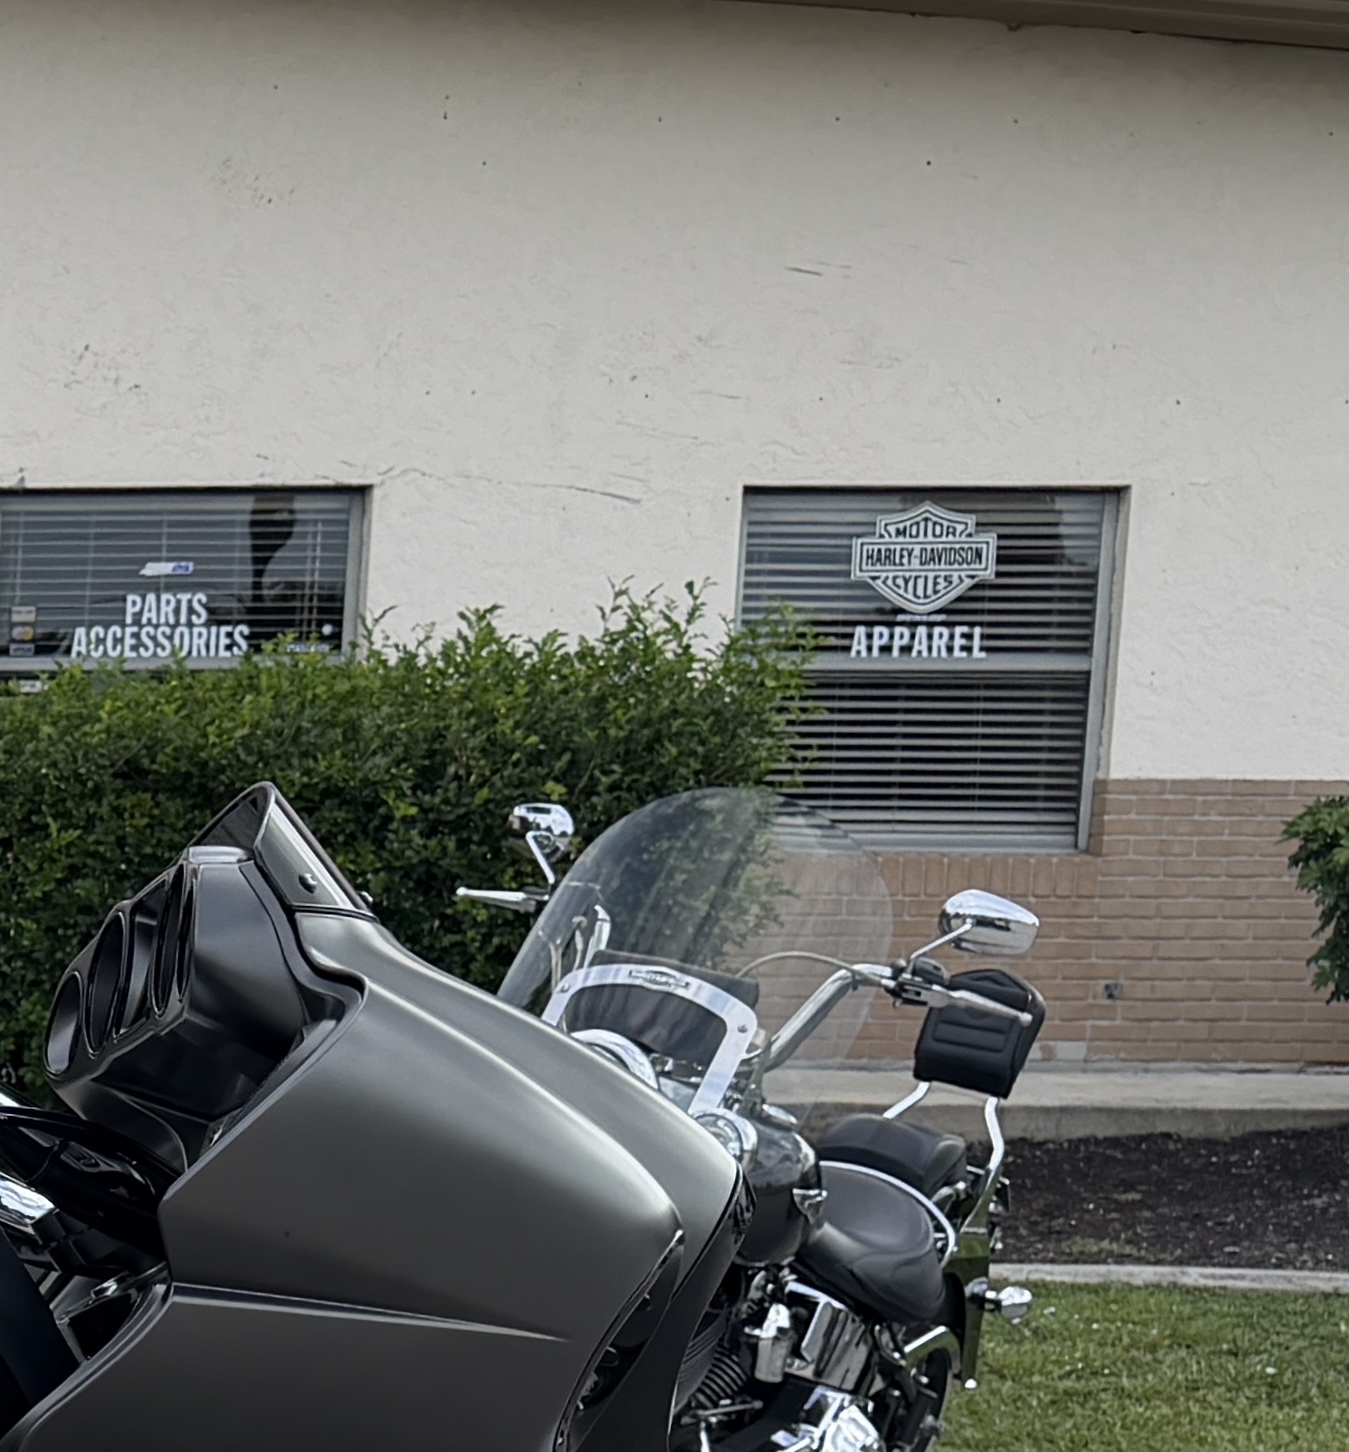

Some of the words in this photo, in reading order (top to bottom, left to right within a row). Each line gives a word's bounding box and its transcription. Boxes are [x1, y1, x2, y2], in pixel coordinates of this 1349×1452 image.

[894, 515, 958, 539] MOTOR
[864, 545, 984, 568] HARLEY-DAVIDSON
[892, 574, 955, 600] CYCLES
[124, 592, 208, 625] PARTS
[70, 624, 251, 659] ACCESSORIES
[850, 625, 988, 659] APPAREL
